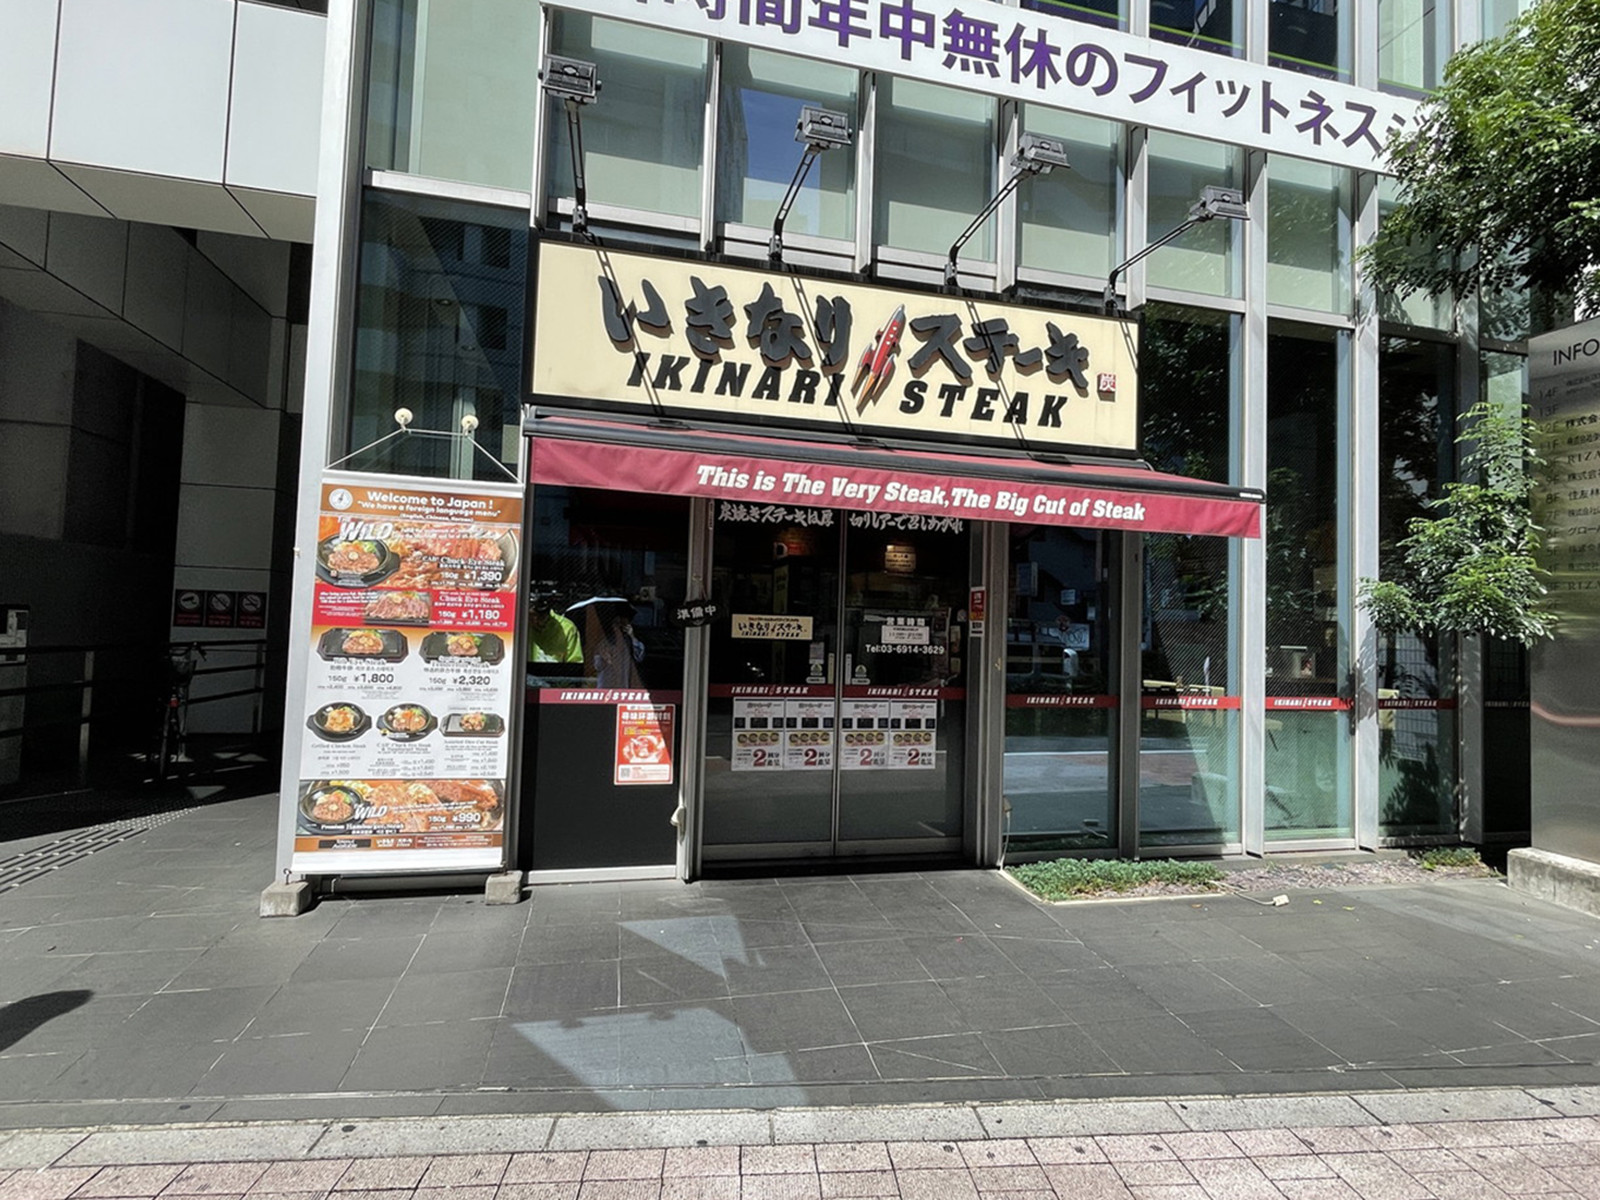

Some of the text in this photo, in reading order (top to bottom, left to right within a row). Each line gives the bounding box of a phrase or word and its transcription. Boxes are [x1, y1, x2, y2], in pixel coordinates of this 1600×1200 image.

[637, 0, 1442, 157] 間年中無休のフィットネス
[598, 275, 1089, 396] いきなり ステーキ
[627, 352, 1067, 428] IKINARI STEAK
[367, 491, 428, 506] Welcome
[431, 496, 444, 506] to
[447, 497, 486, 509] Japan
[697, 465, 750, 488] This
[753, 470, 776, 491] is
[782, 472, 826, 495] The
[831, 477, 881, 504] Very
[995, 491, 1029, 516] Big
[1033, 495, 1066, 515] Cut
[1069, 498, 1091, 517] of
[1092, 500, 1145, 521] Steak
[376, 502, 396, 511] have
[406, 504, 435, 514] foreign
[436, 506, 473, 516] language
[677, 605, 716, 620] 準備中
[354, 673, 394, 683] ¥1,800
[453, 675, 491, 685] ¥2,320
[560, 692, 650, 701] IKINARI STEAK
[731, 686, 768, 694] IKINARI
[753, 749, 767, 767] 2
[804, 748, 817, 766] 2
[860, 748, 872, 766] 2
[907, 748, 920, 766] 2
